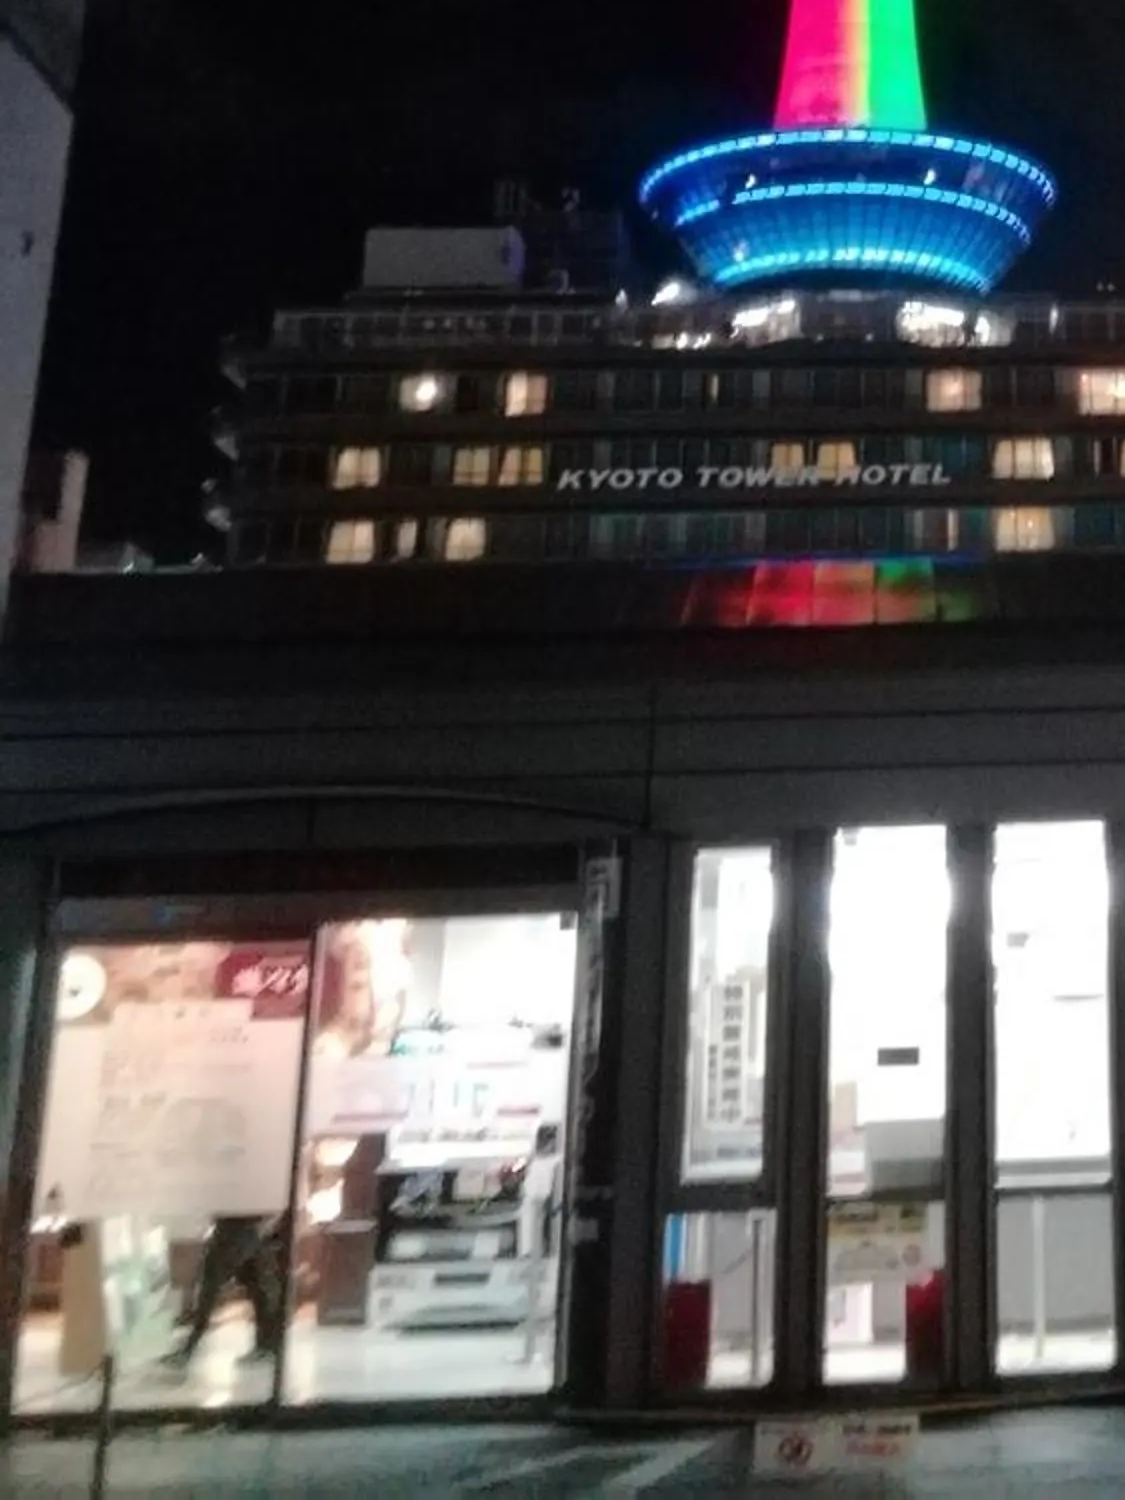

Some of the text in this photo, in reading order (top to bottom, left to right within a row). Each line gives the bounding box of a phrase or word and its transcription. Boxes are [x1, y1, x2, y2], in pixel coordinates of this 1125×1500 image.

[557, 463, 952, 490] KYOTO TOWER HOTEL
